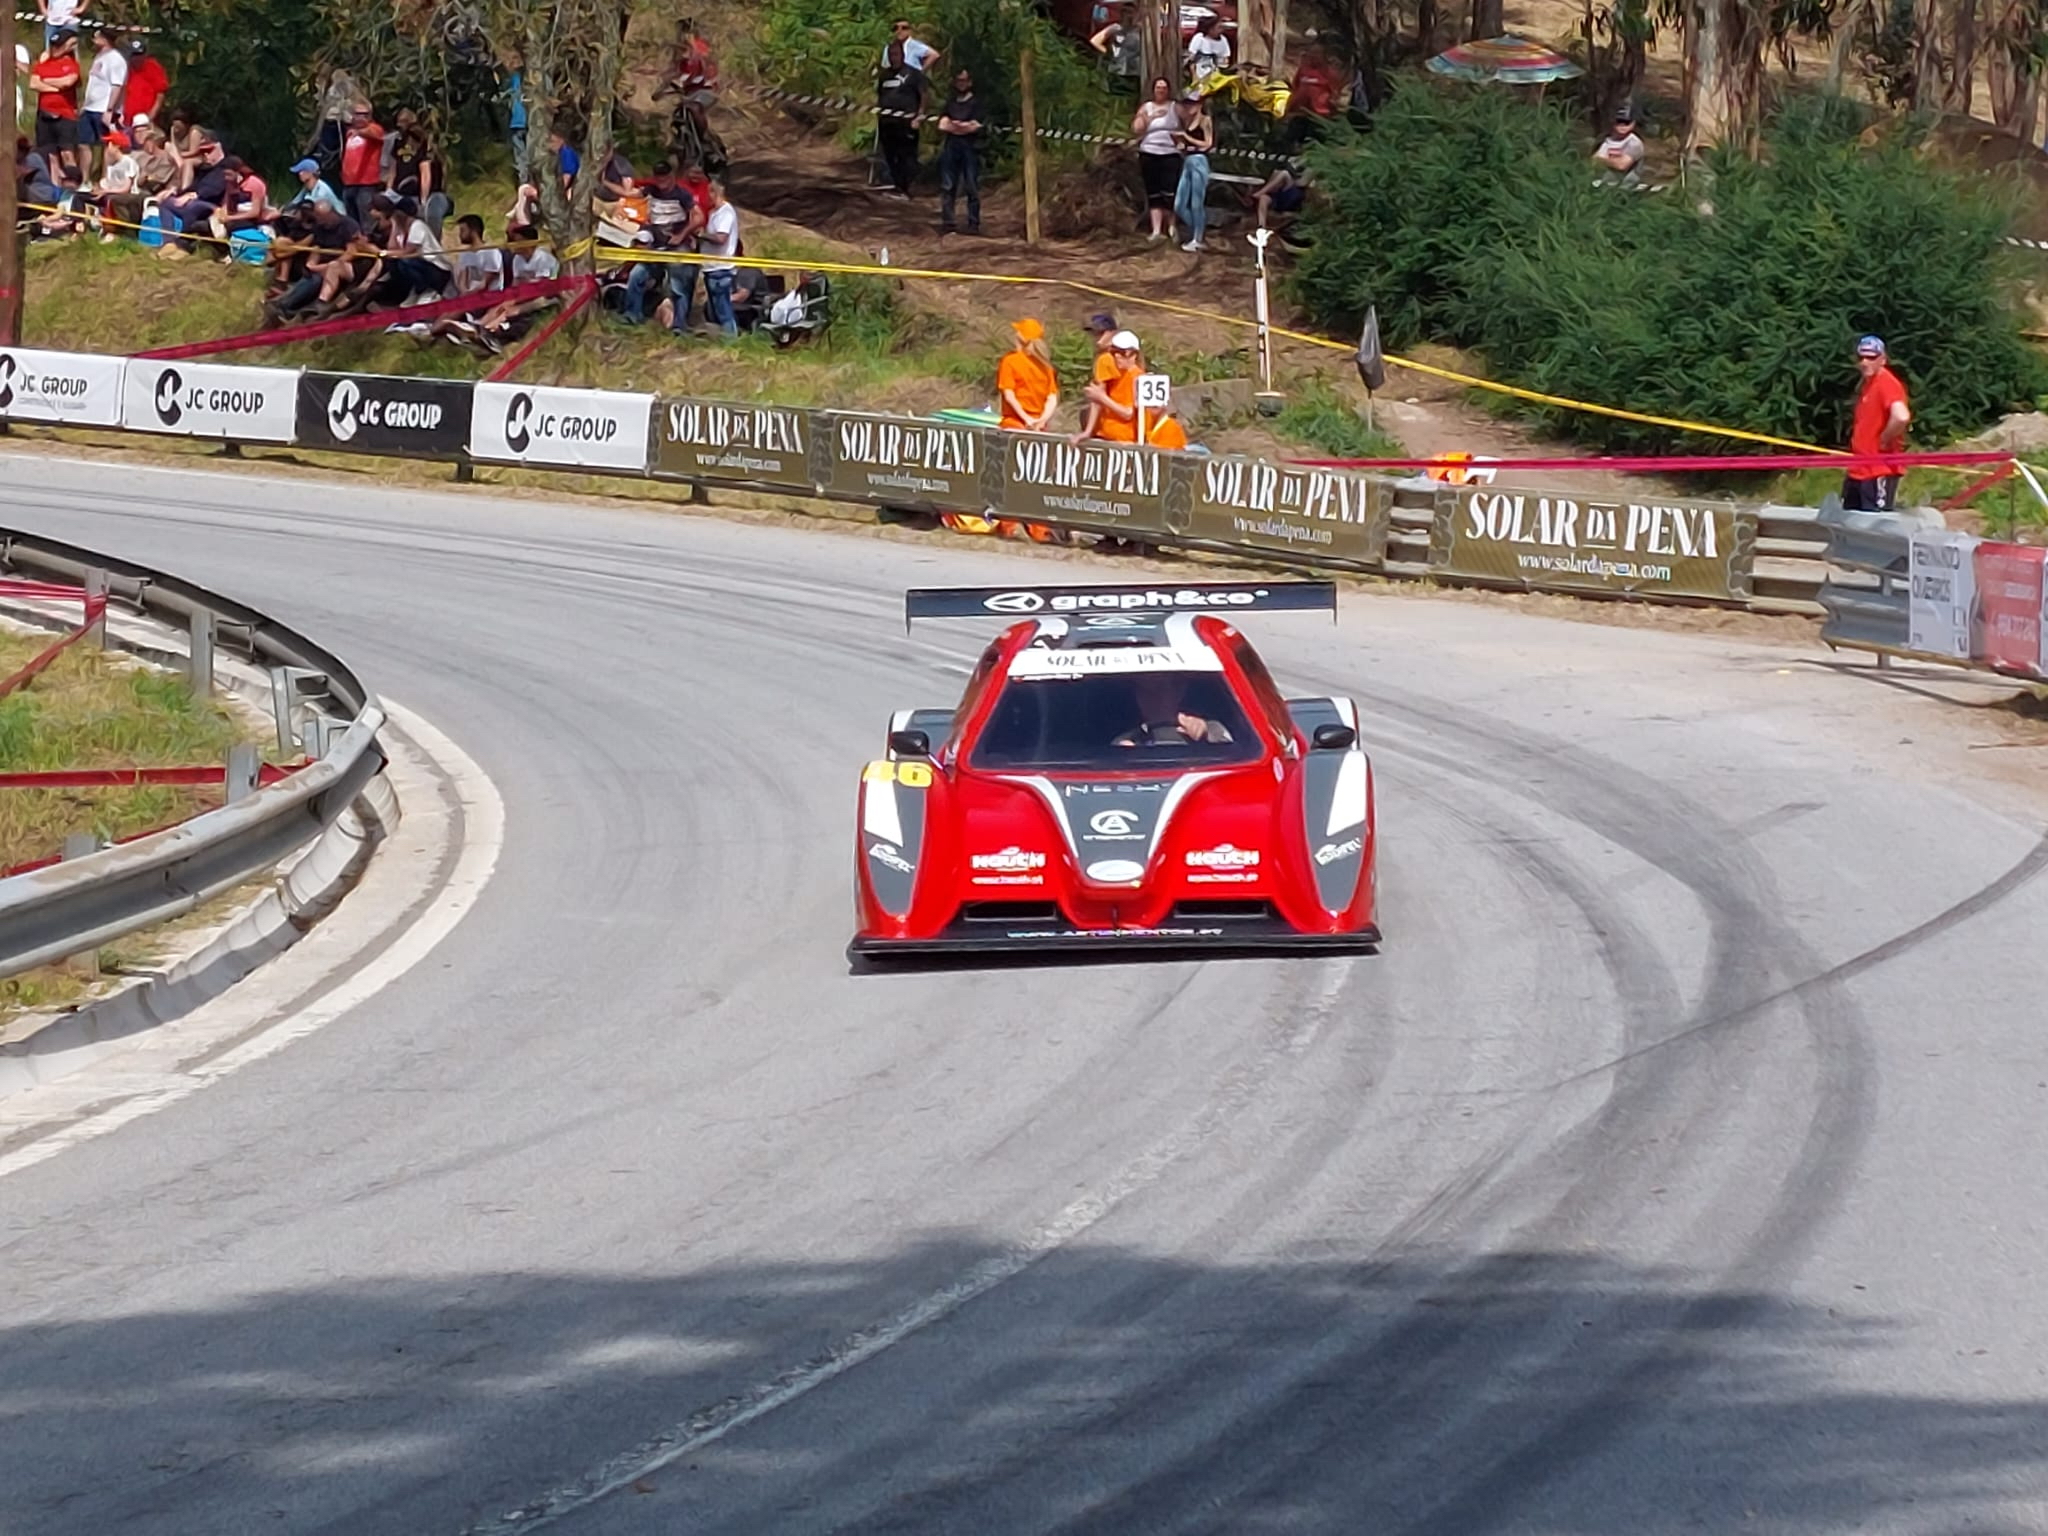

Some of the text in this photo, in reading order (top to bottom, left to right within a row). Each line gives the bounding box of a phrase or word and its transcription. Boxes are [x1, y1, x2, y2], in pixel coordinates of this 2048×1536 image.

[19, 373, 87, 397] JC GROUP
[1142, 380, 1166, 401] 35
[185, 388, 264, 414] JC GROUP
[359, 399, 442, 429] JC GROUP
[534, 414, 617, 442] JC GROUP
[667, 403, 729, 447] SOLAR
[753, 409, 805, 454] PENA
[839, 420, 900, 467] SOLAR
[923, 427, 975, 474] PENA
[1012, 439, 1160, 496] SOLAR DA PENA
[1202, 460, 1366, 524] SOLAR DA PENA
[1465, 492, 1718, 558] SOLAR DA PENA
[1517, 552, 1671, 581] www.solardapena.com
